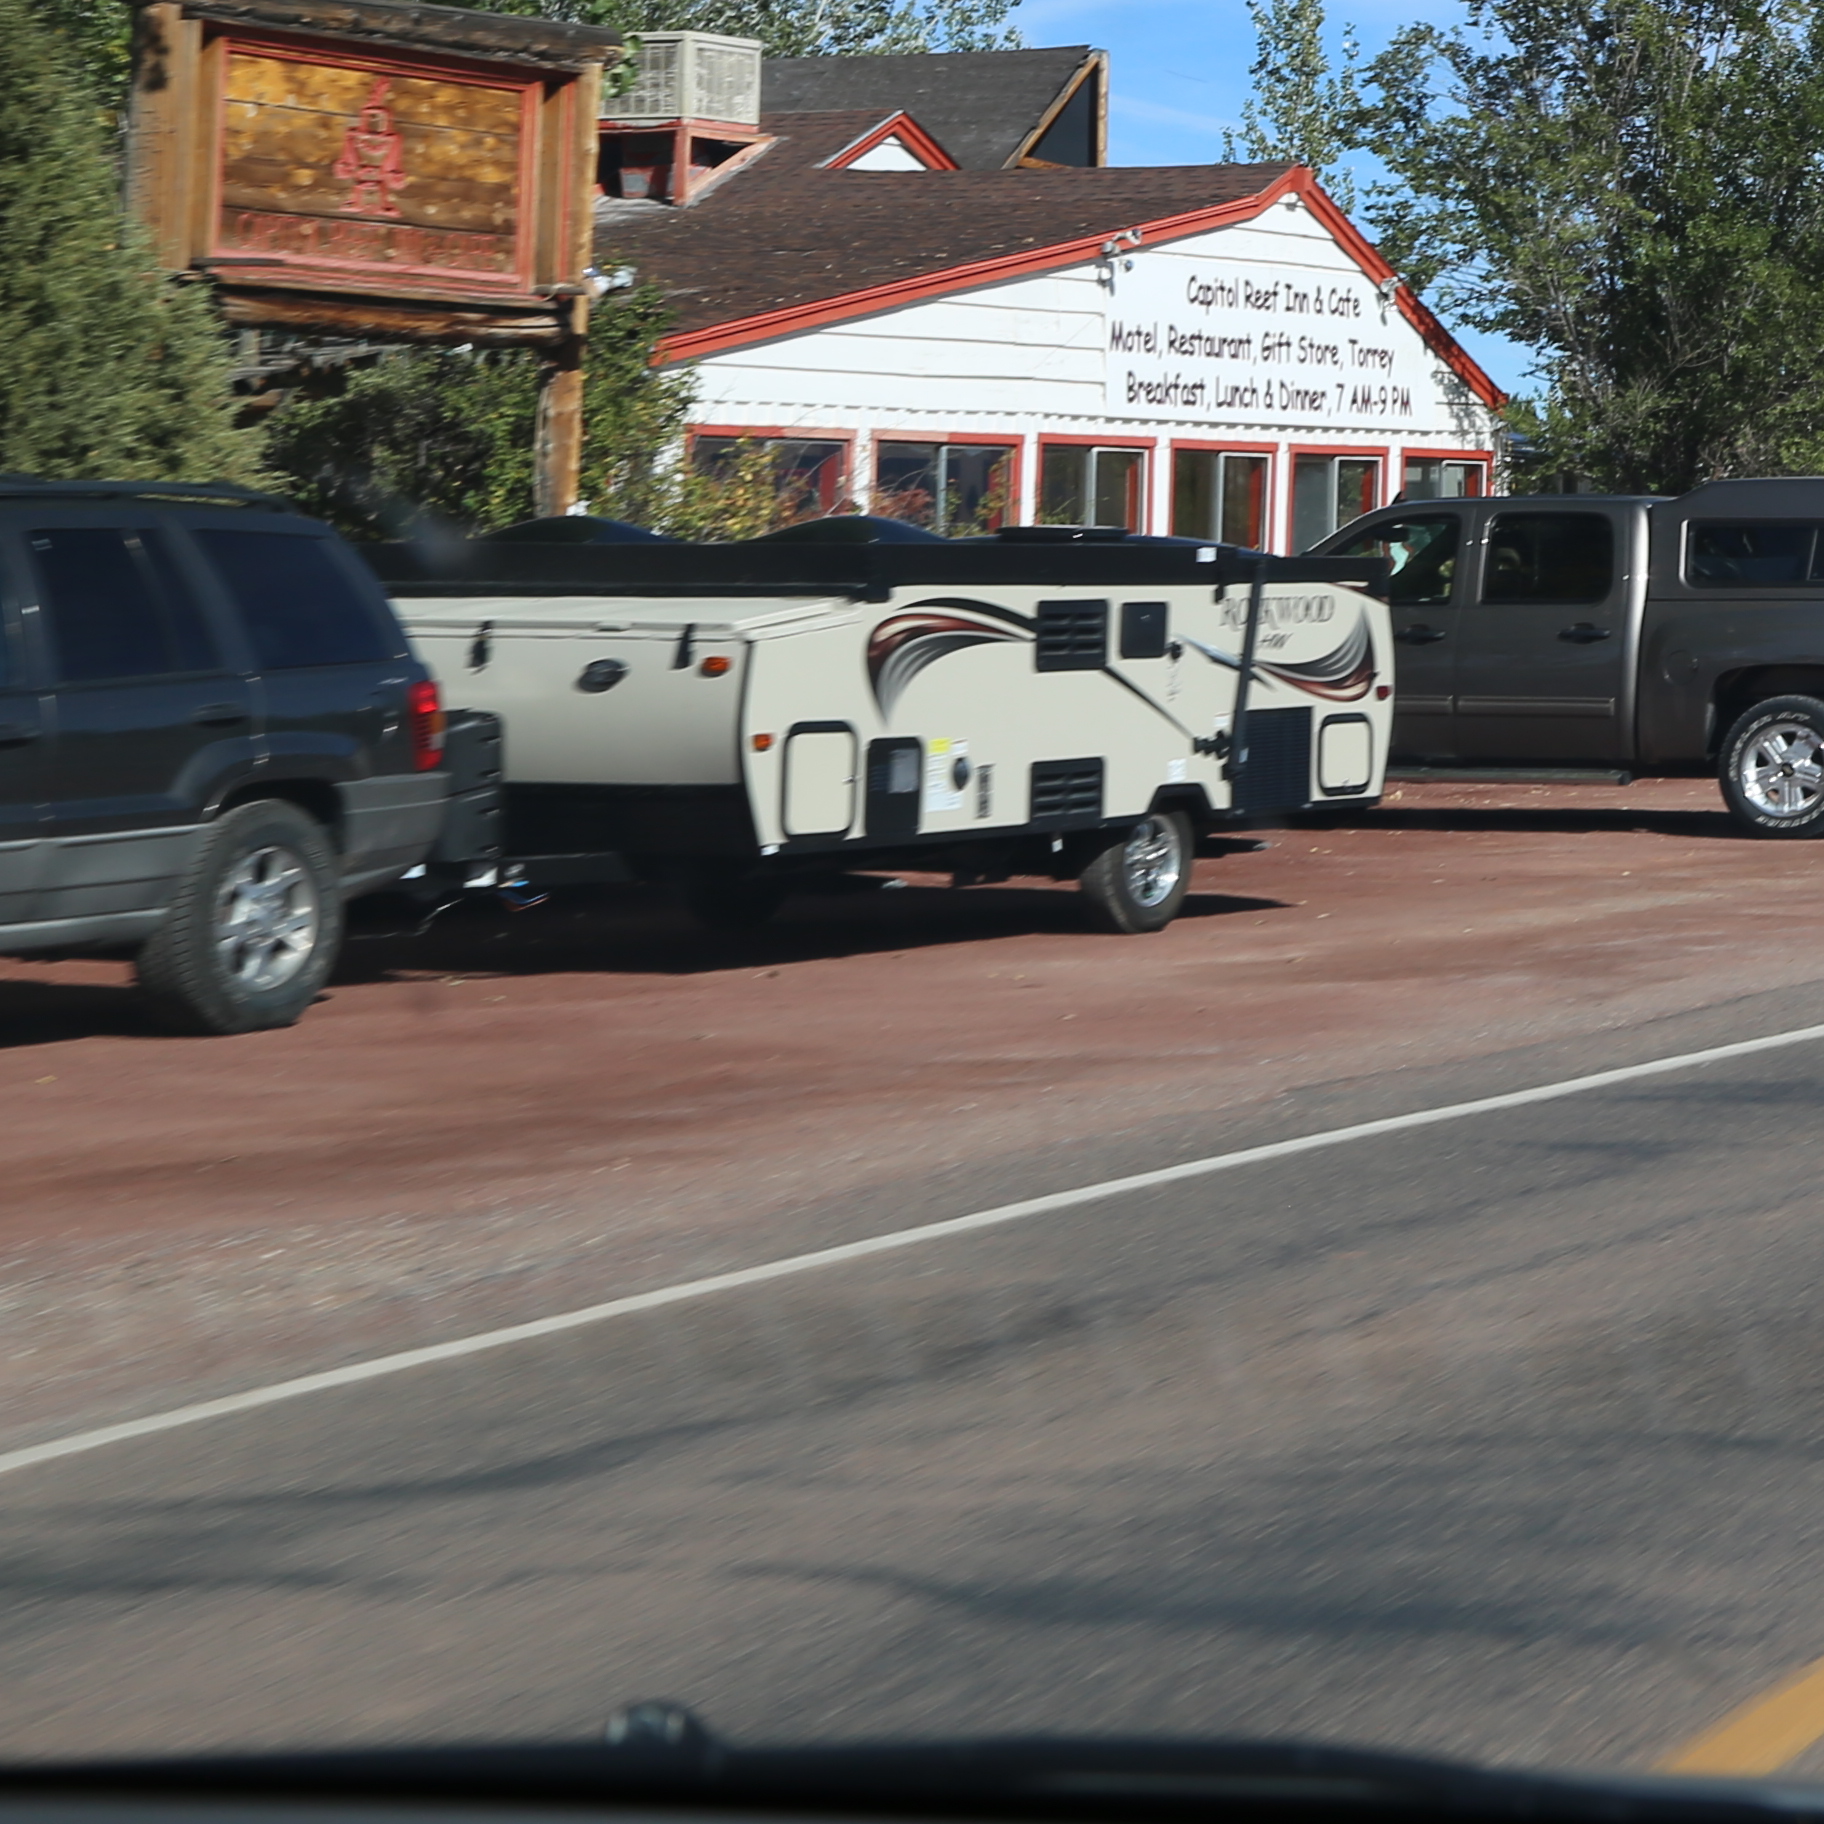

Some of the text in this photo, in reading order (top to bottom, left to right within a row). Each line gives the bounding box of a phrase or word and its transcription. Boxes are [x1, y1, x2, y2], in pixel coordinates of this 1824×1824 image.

[1187, 275, 1361, 318] Capitol Reef Inn & Cafe
[1110, 321, 1394, 378] Motel, Restaurant, Gift Store, Torrey
[1127, 370, 1412, 417] Breakfast, Lunch & Dinner, 7 AM-9 PM
[1219, 595, 1335, 631] ROKWOOD
